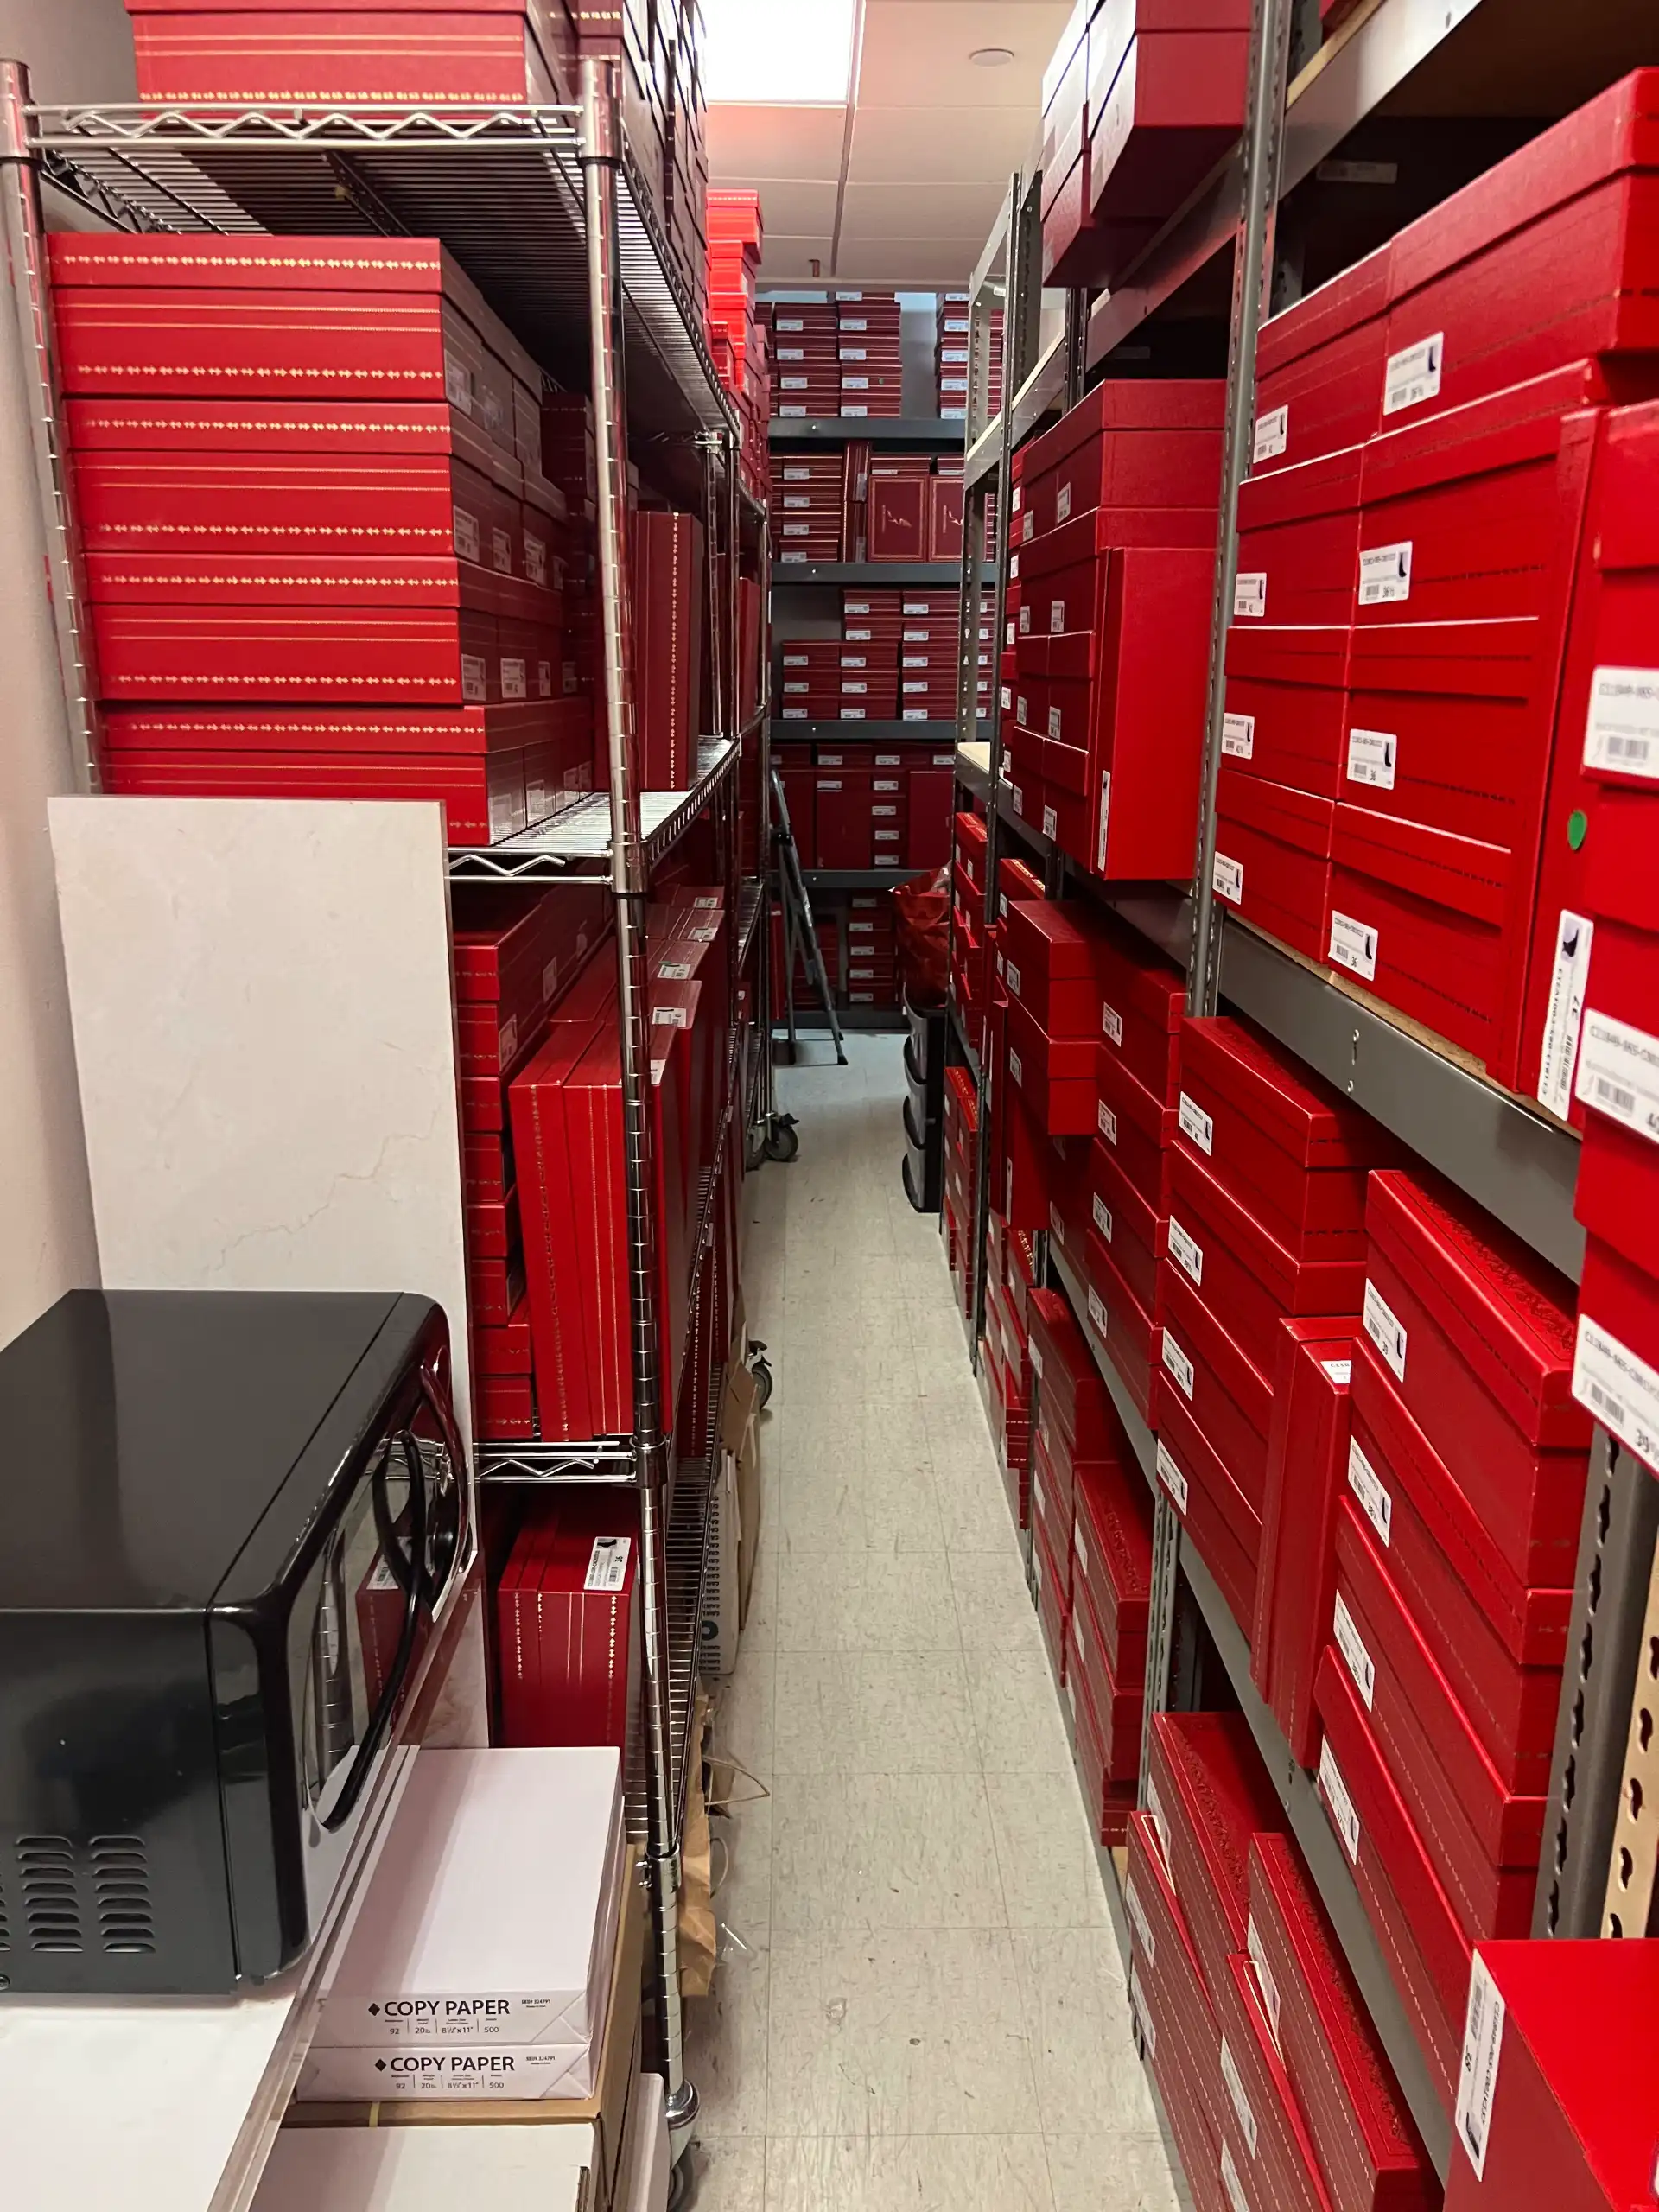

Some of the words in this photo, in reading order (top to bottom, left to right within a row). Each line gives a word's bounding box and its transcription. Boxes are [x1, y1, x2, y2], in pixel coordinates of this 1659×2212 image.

[385, 2001, 441, 2016] COPY
[446, 1999, 511, 2015] PAPER
[391, 2057, 446, 2072] COPY
[451, 2056, 516, 2071] PAPER
